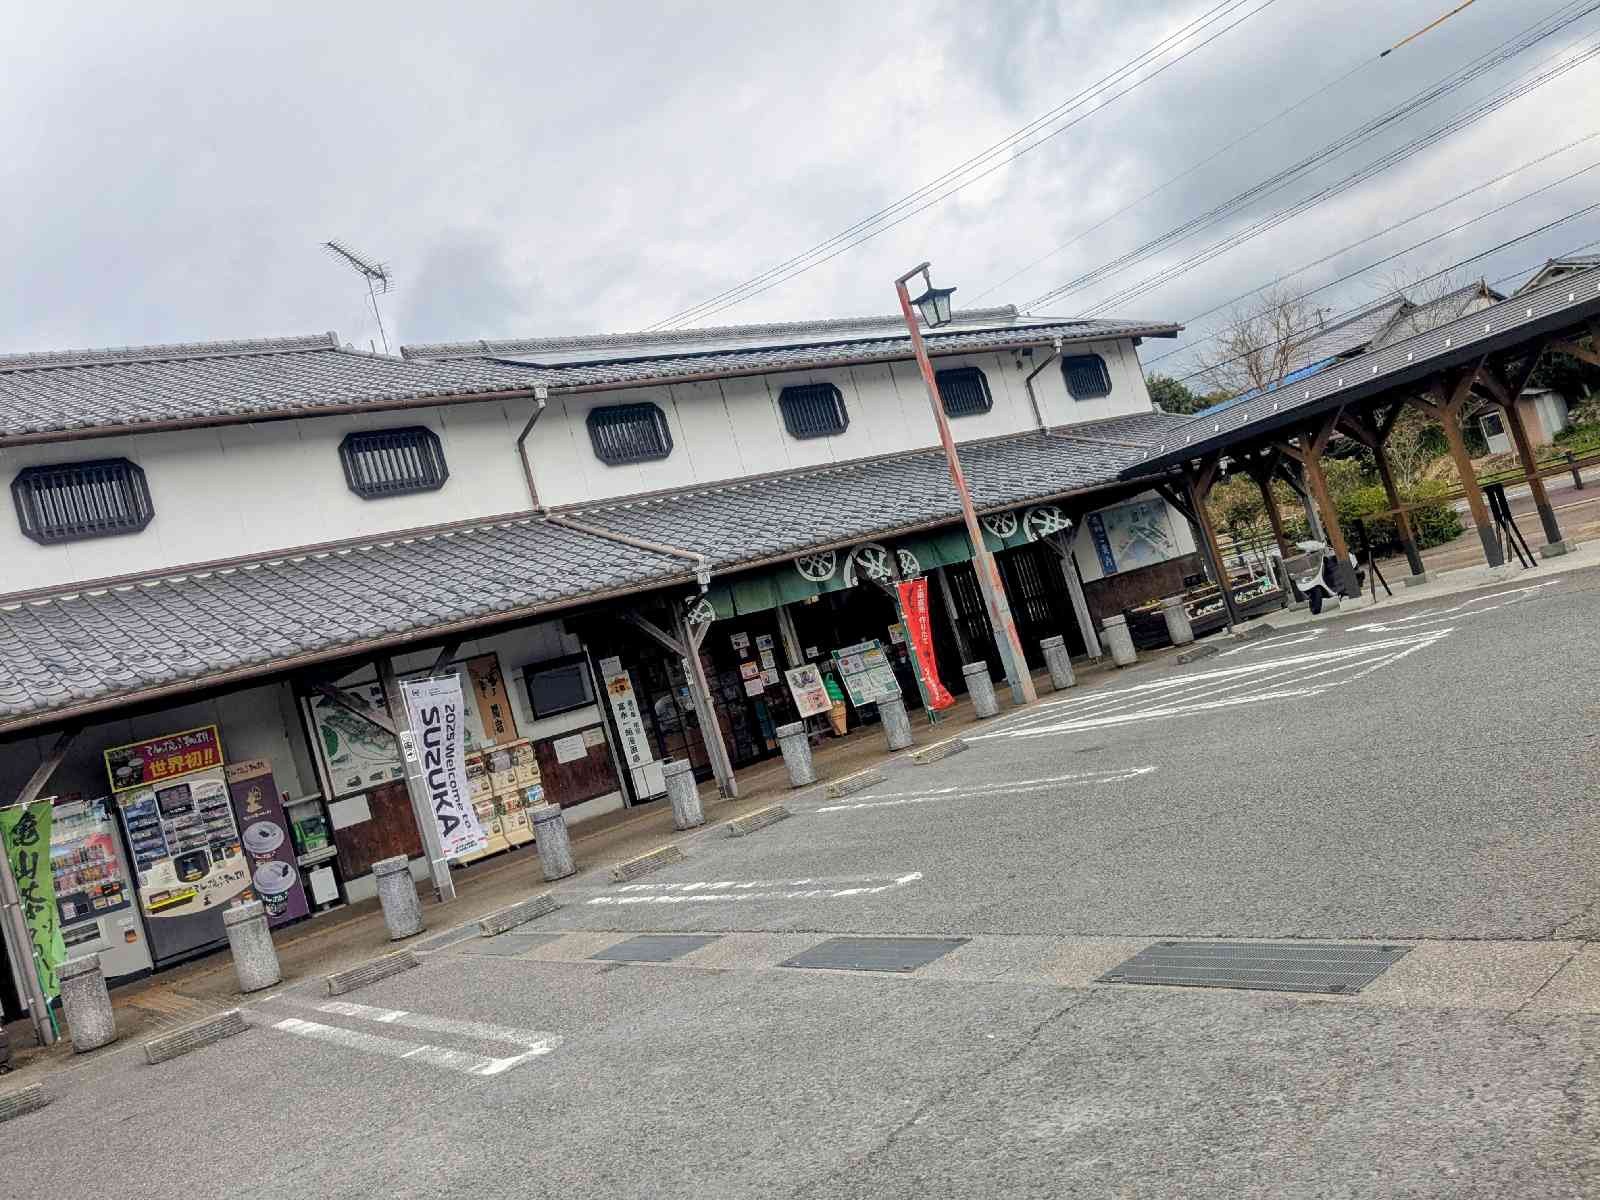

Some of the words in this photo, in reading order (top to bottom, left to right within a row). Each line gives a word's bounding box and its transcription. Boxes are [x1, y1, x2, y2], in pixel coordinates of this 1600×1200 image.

[445, 703, 456, 740] 2025
[420, 706, 461, 838] SUZUKA
[447, 743, 465, 811] Welcome
[462, 814, 472, 829] to
